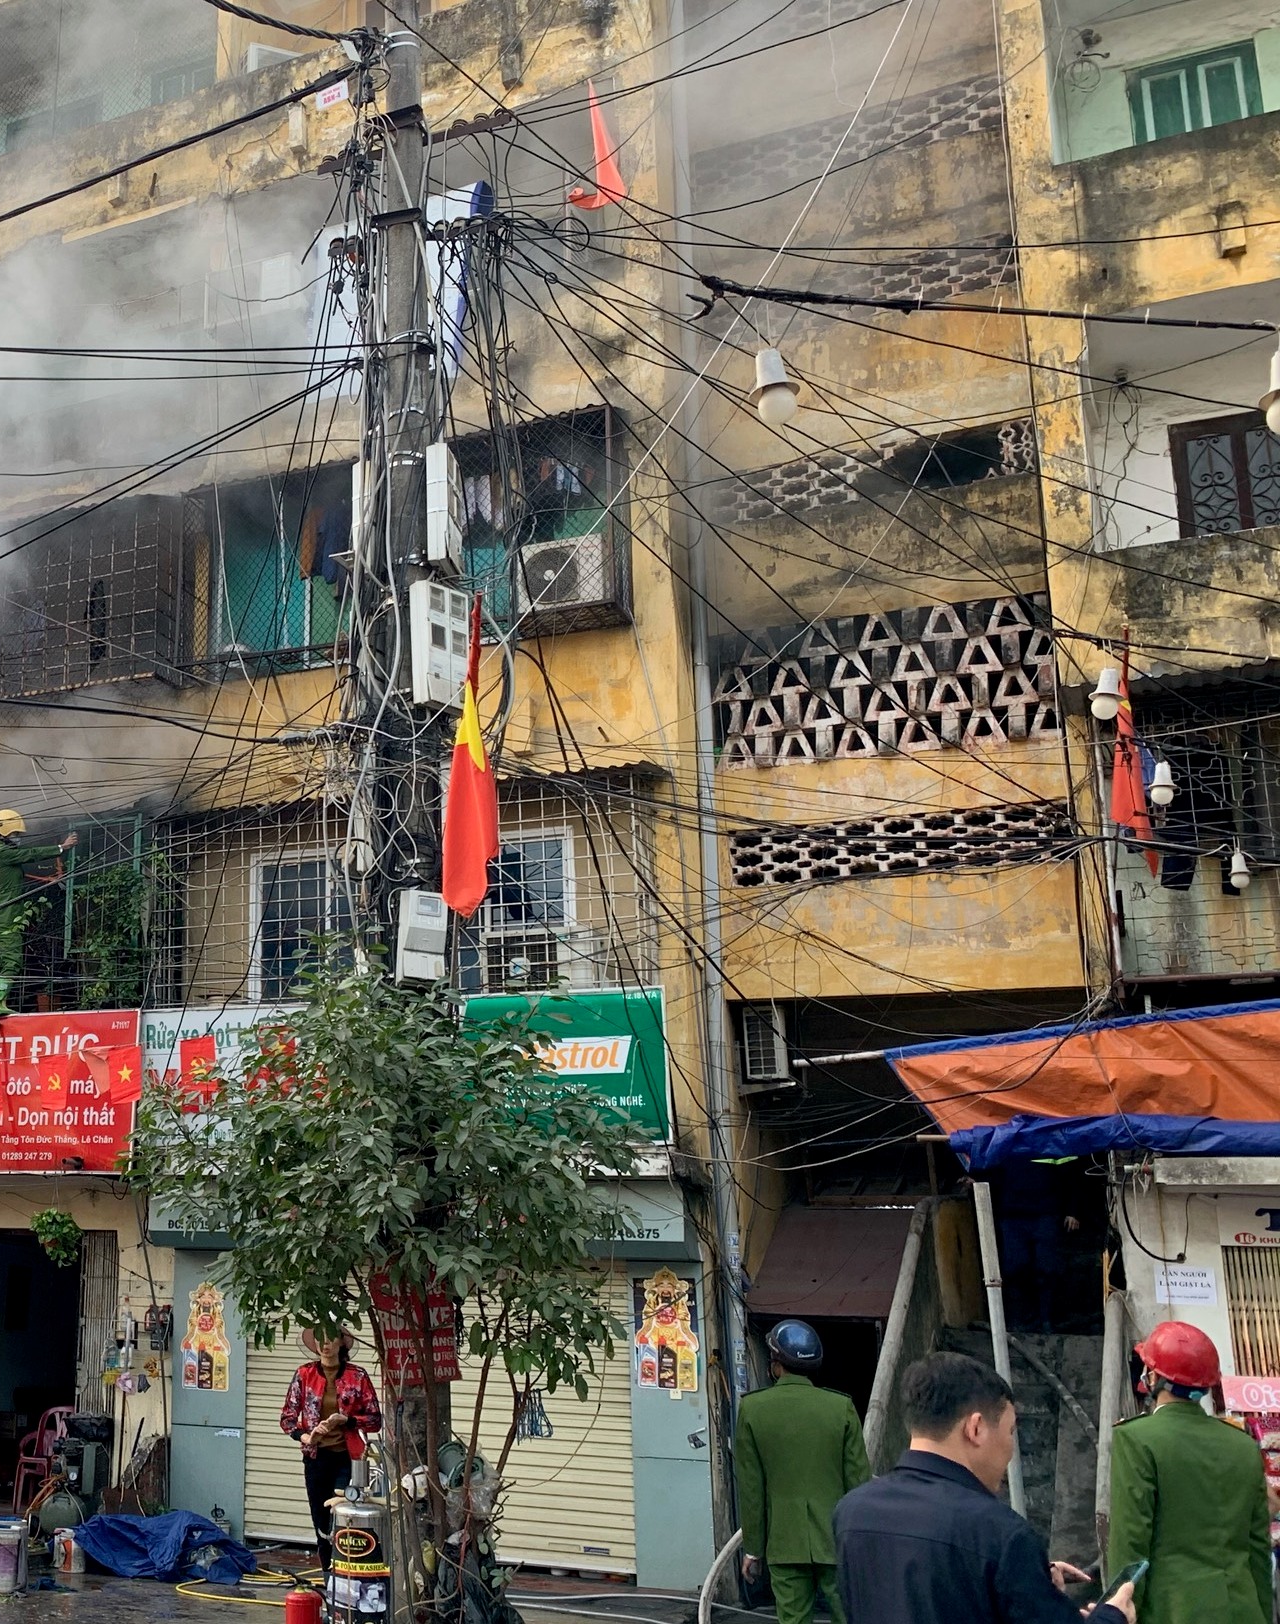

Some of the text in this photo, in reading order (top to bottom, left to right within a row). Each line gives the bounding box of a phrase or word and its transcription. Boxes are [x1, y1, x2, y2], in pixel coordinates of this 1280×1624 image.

[528, 1041, 619, 1070] astrol
[18, 1108, 49, 1130] Dọn
[54, 1107, 78, 1130] nội
[82, 1102, 115, 1127] thất
[24, 1152, 38, 1160] 247
[39, 1152, 52, 1160] 279
